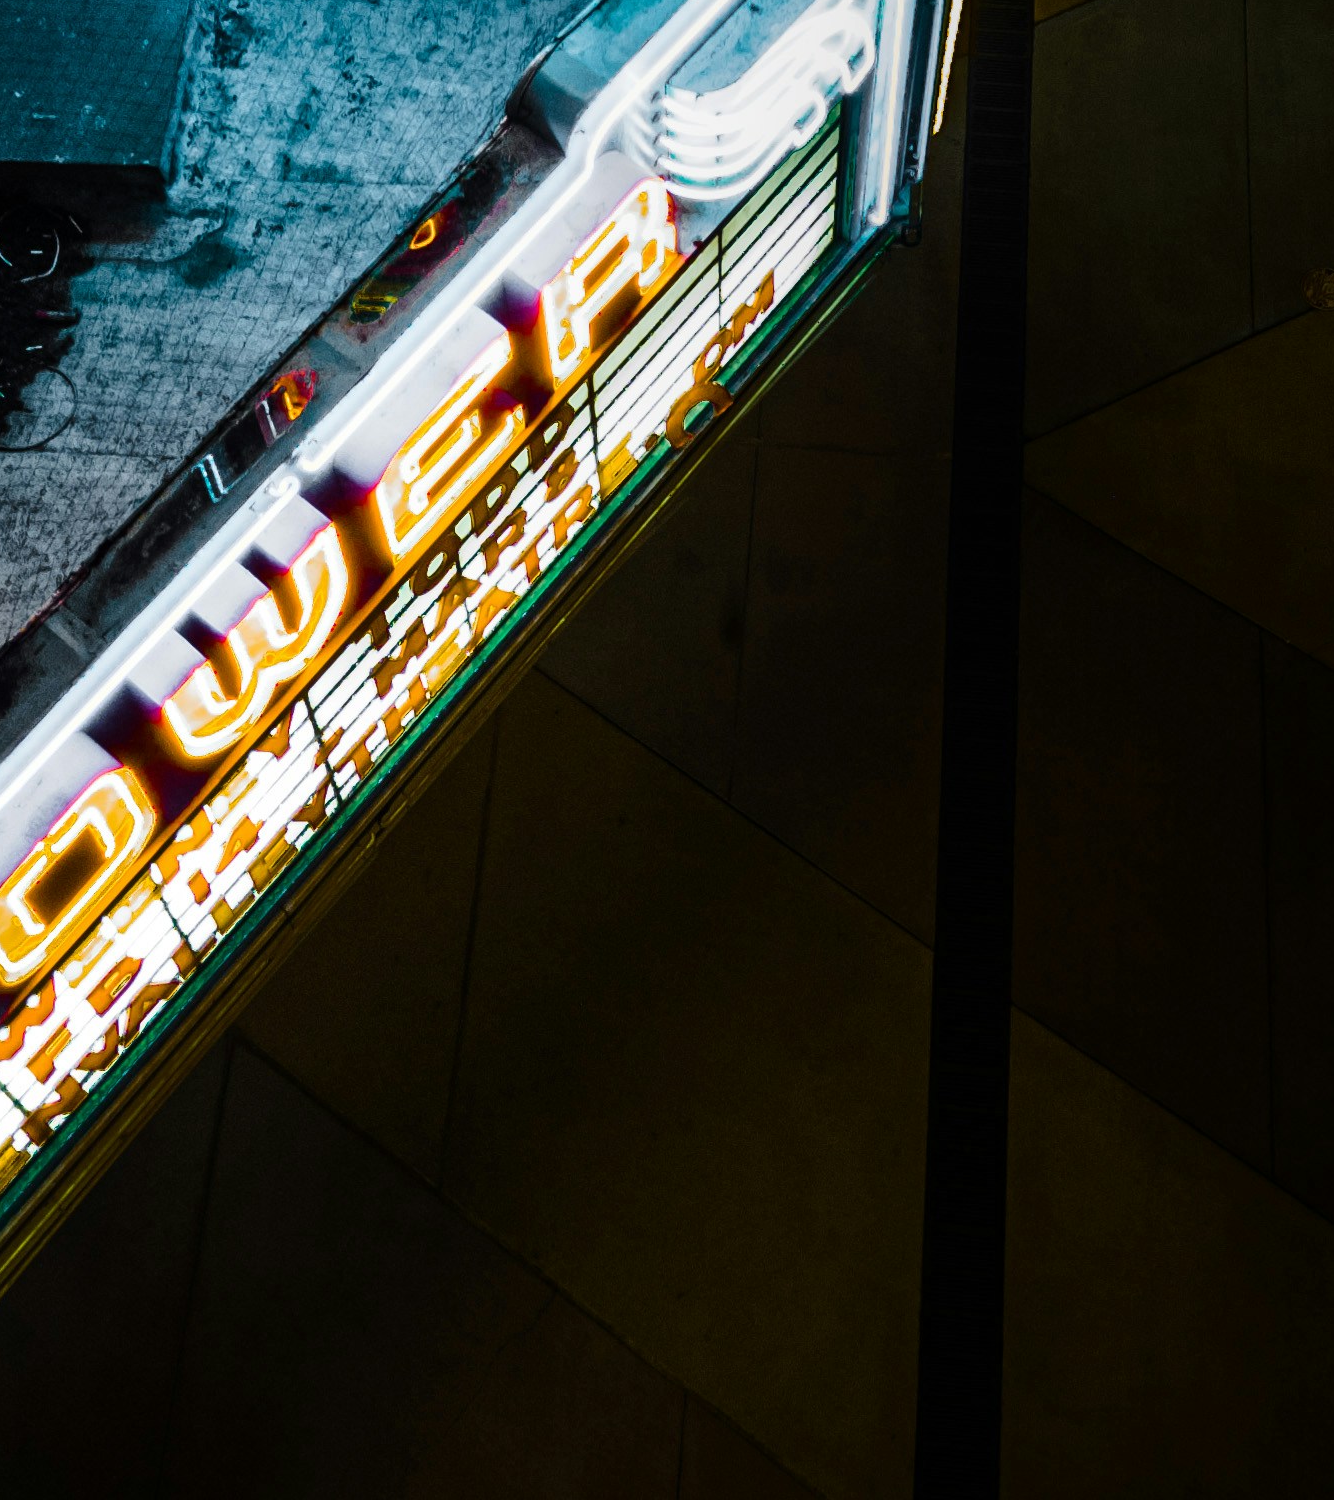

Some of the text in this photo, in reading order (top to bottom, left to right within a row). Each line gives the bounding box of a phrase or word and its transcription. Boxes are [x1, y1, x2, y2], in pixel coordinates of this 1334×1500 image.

[187, 813, 264, 905] 14
[368, 508, 525, 698] MAR
[547, 446, 576, 501] 8
[351, 400, 573, 650] TODD
